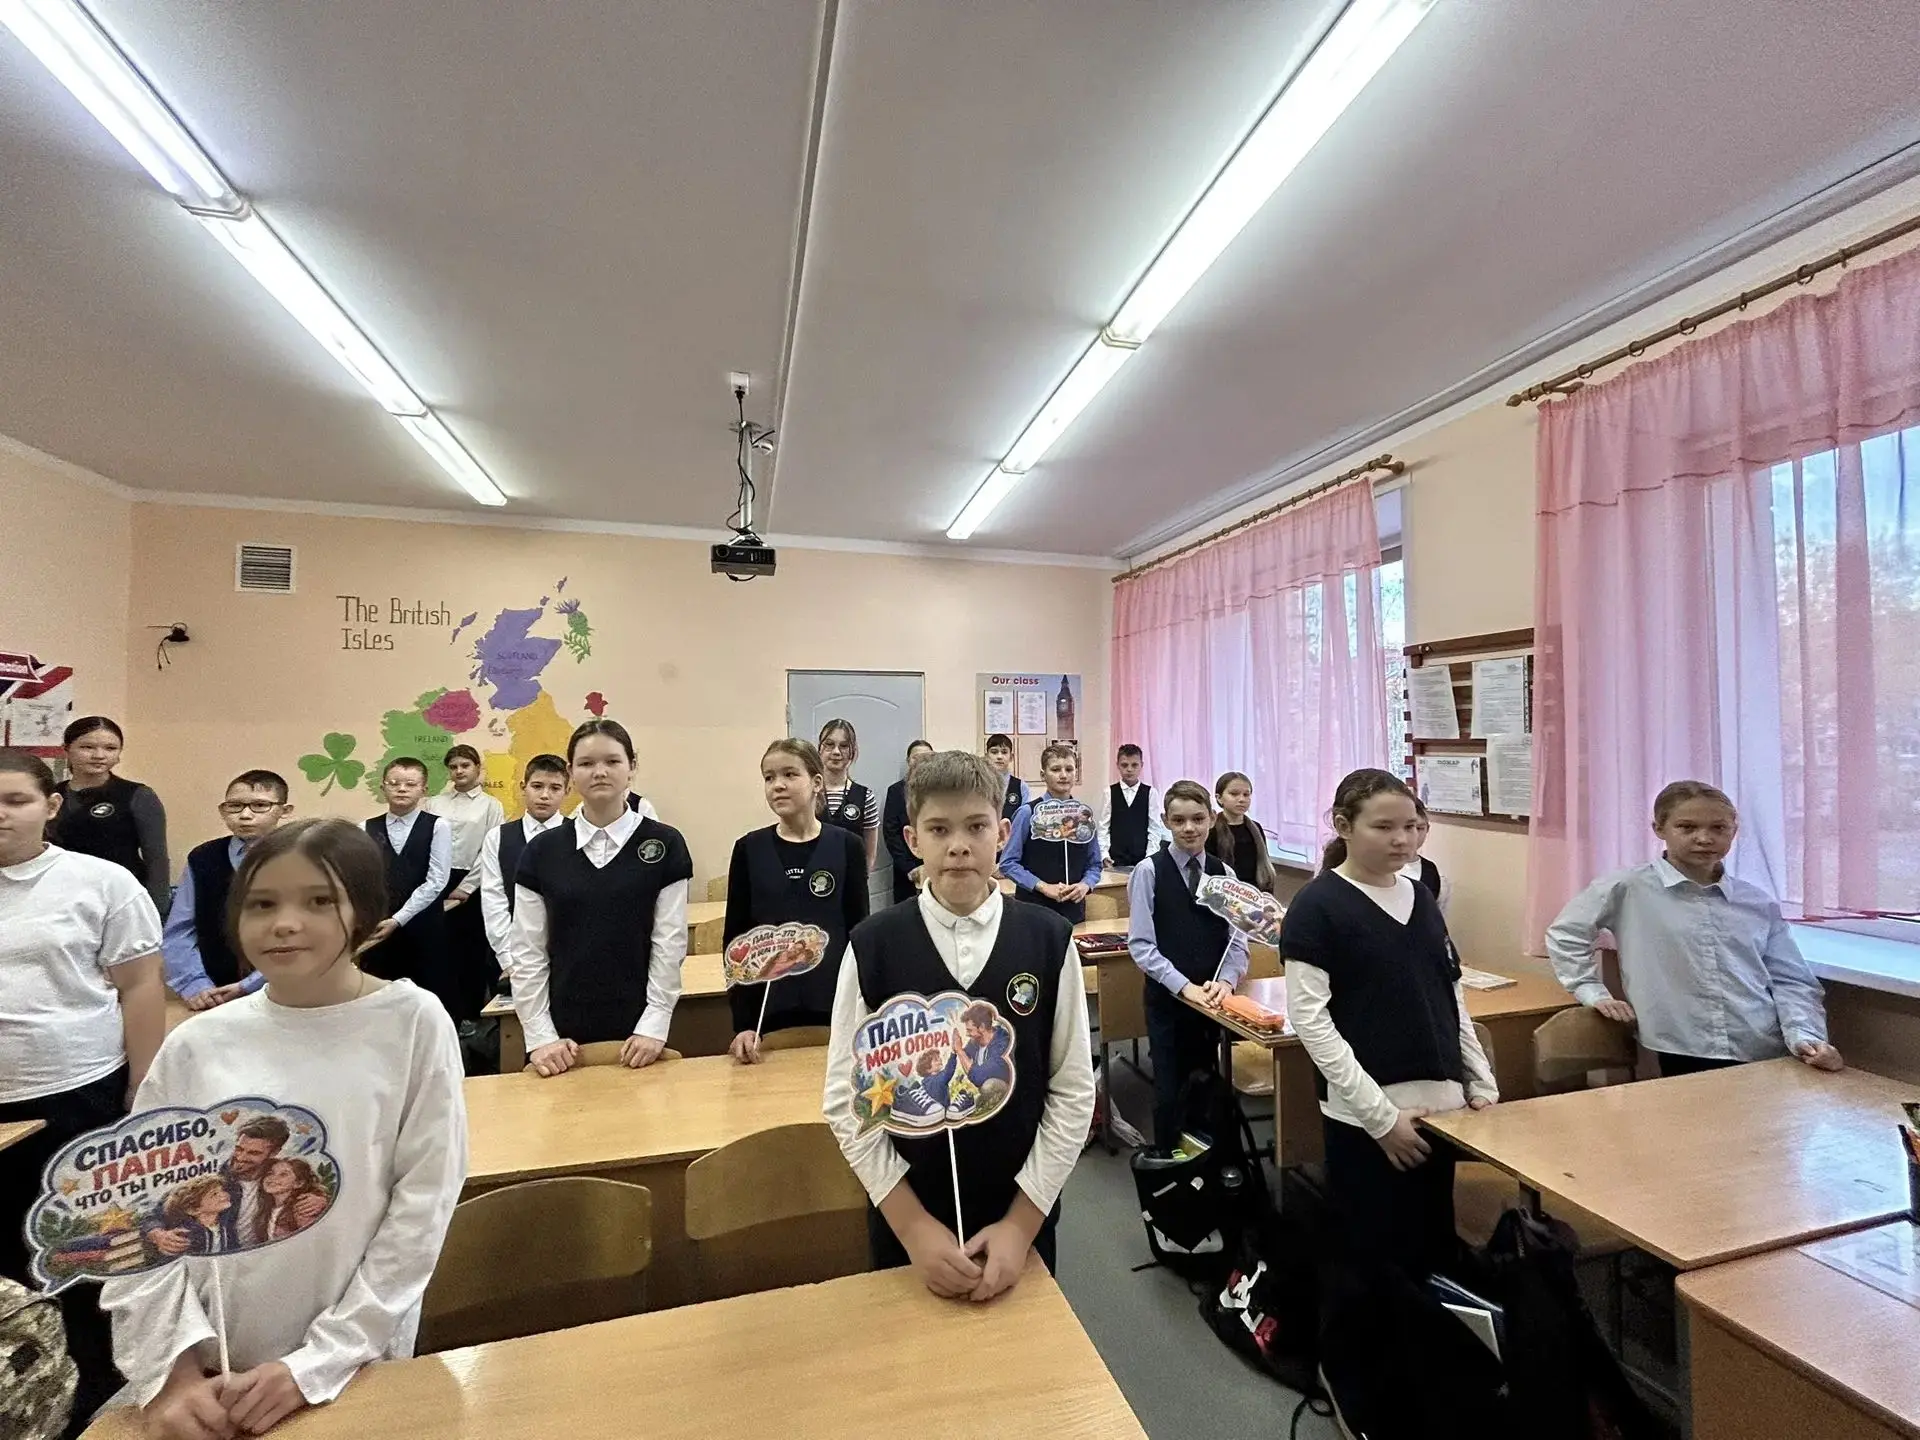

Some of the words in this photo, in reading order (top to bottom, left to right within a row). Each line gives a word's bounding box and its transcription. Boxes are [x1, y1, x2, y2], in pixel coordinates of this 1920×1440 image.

[336, 595, 378, 623] The
[390, 598, 451, 626] British
[991, 676, 1010, 685] Our
[1013, 676, 1039, 685] class
[414, 735, 449, 743] IRELAND
[1222, 881, 1259, 902] СПАСИБО
[753, 932, 774, 944] ПАПА
[865, 1043, 901, 1072] МОЯ
[904, 1029, 950, 1055] ОПОРА
[73, 1117, 217, 1172] СПАСИБО,
[93, 1142, 205, 1191] ПАПА,
[75, 1188, 112, 1210] ЧТО
[117, 1180, 147, 1200] ТЫ
[152, 1158, 219, 1192] РЯДОМ!
